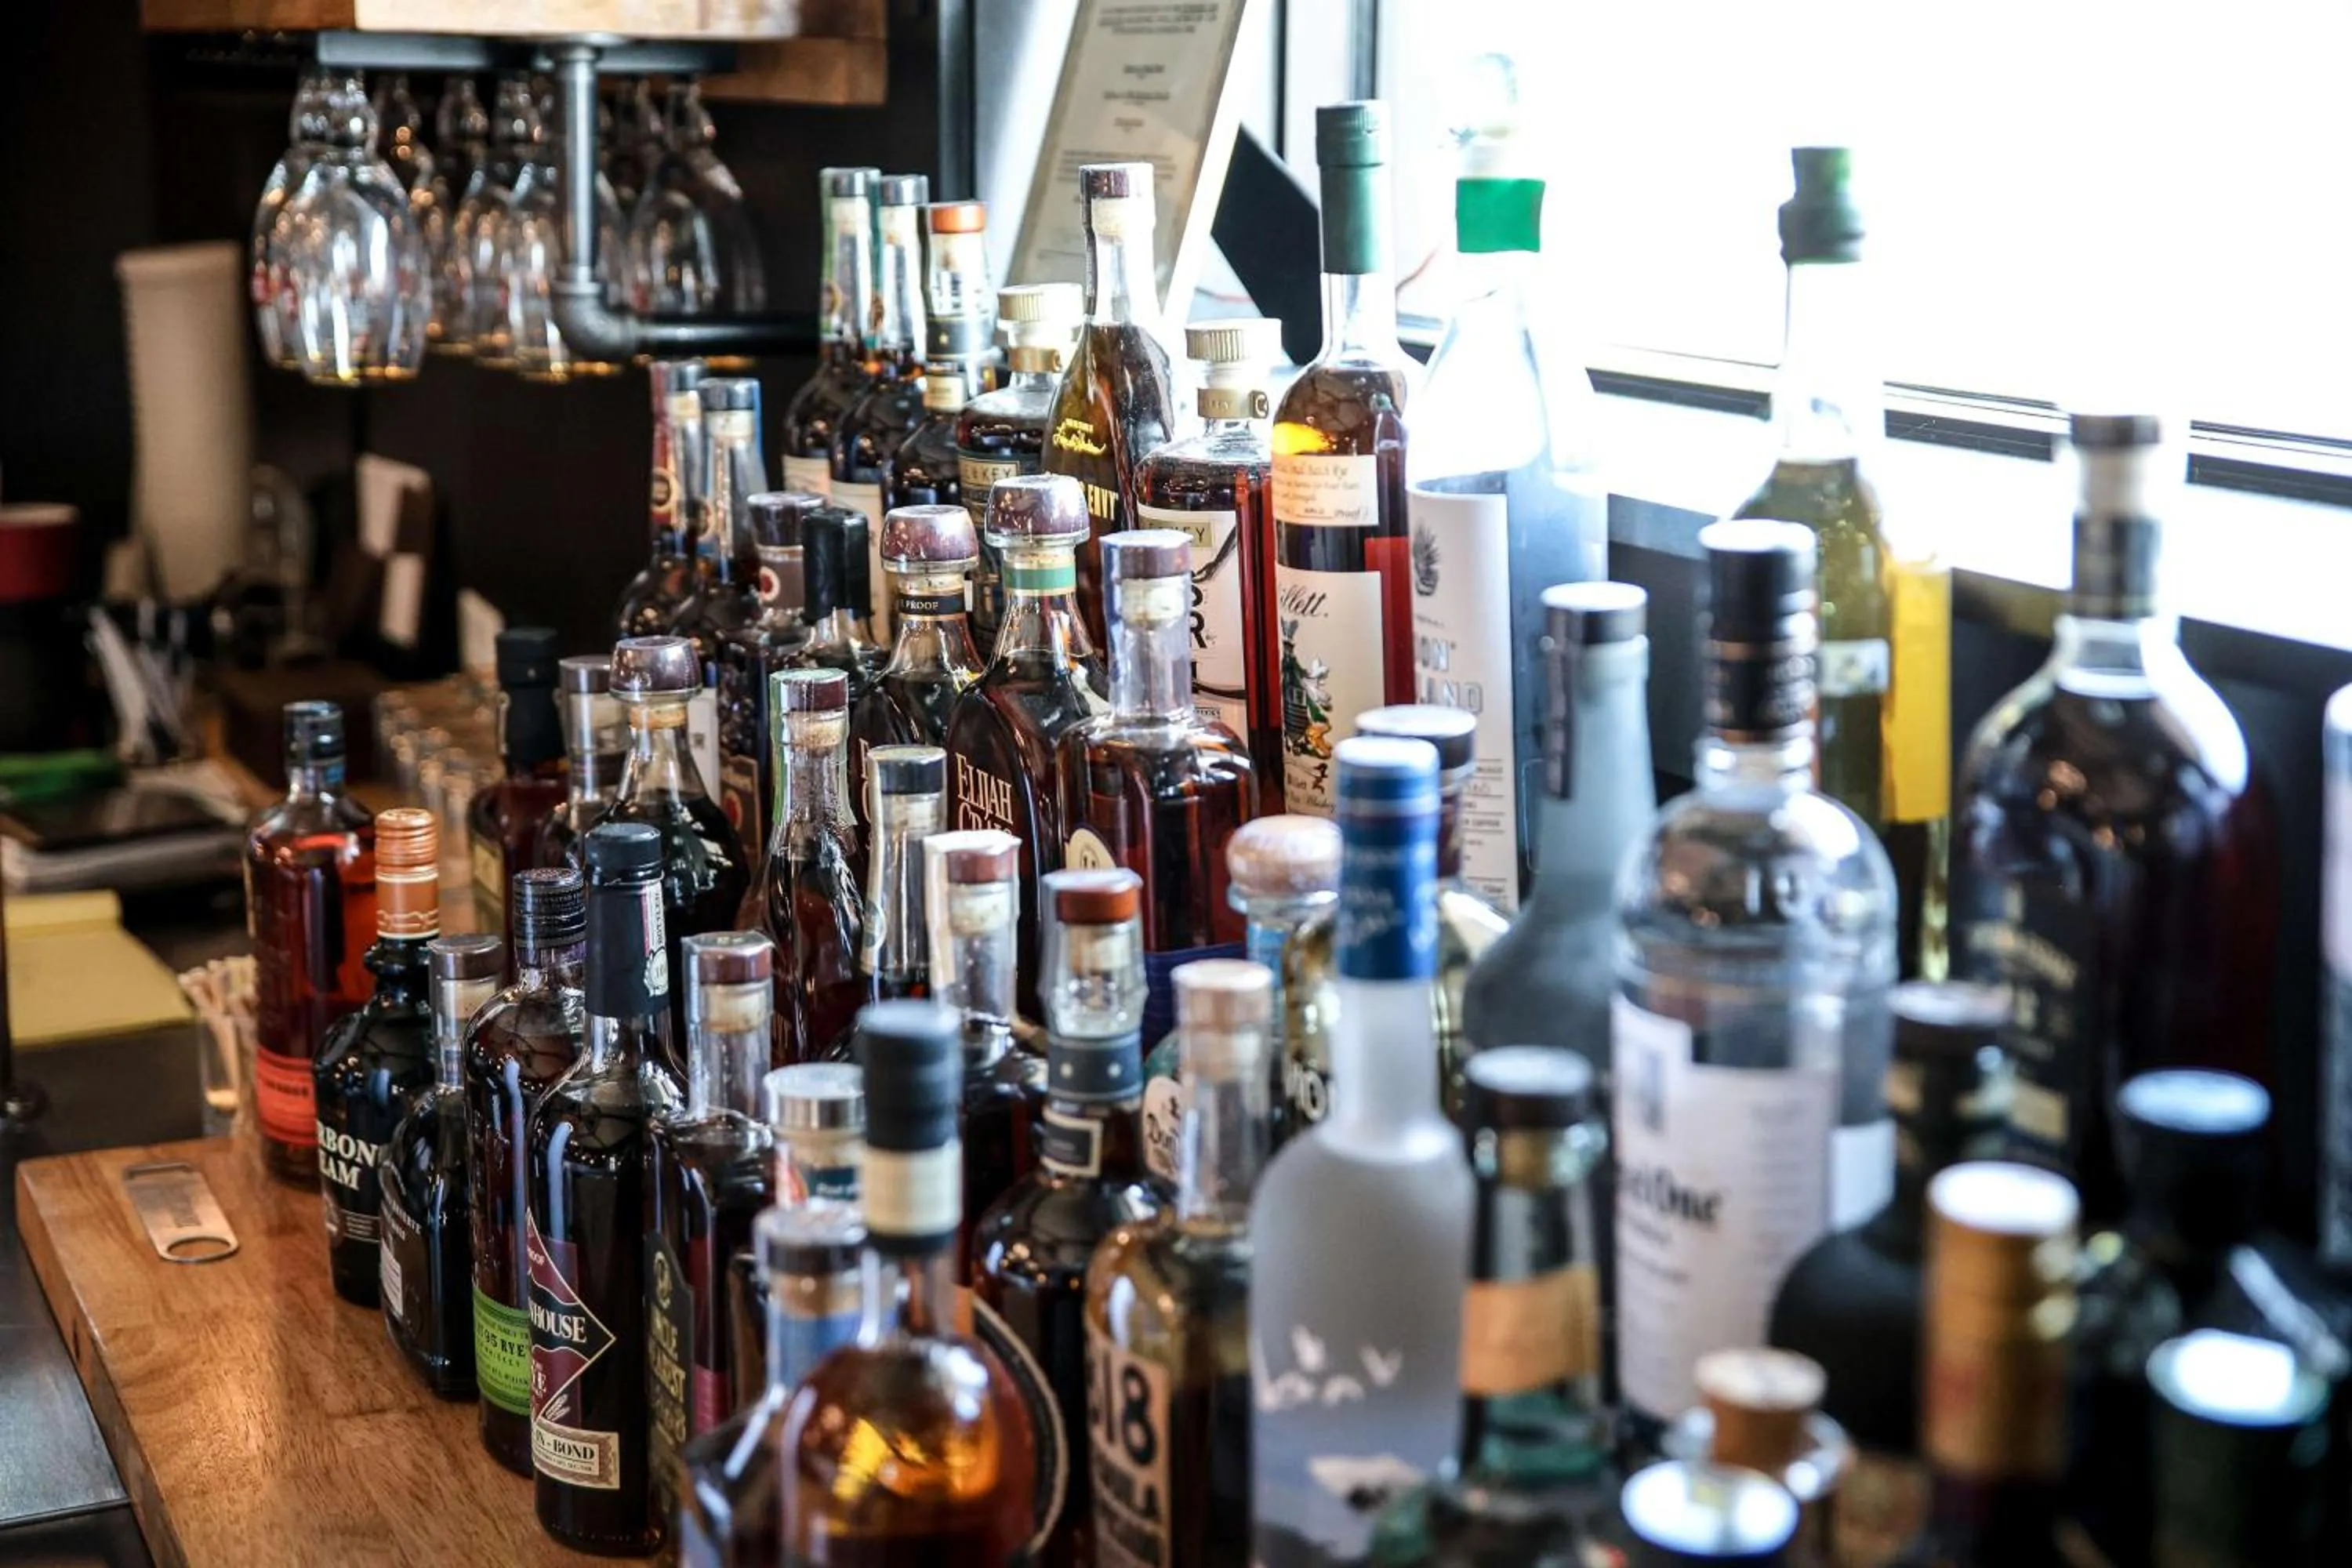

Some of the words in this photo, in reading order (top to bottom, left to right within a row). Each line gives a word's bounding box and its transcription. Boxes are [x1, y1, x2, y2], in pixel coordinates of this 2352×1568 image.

[1087, 483, 1115, 521] ENVY
[906, 600, 939, 610] PROOF
[1280, 584, 1329, 619] illett.
[956, 752, 1014, 825] ELIJAH
[500, 1338, 526, 1357] RYE
[554, 1439, 595, 1461] BOND
